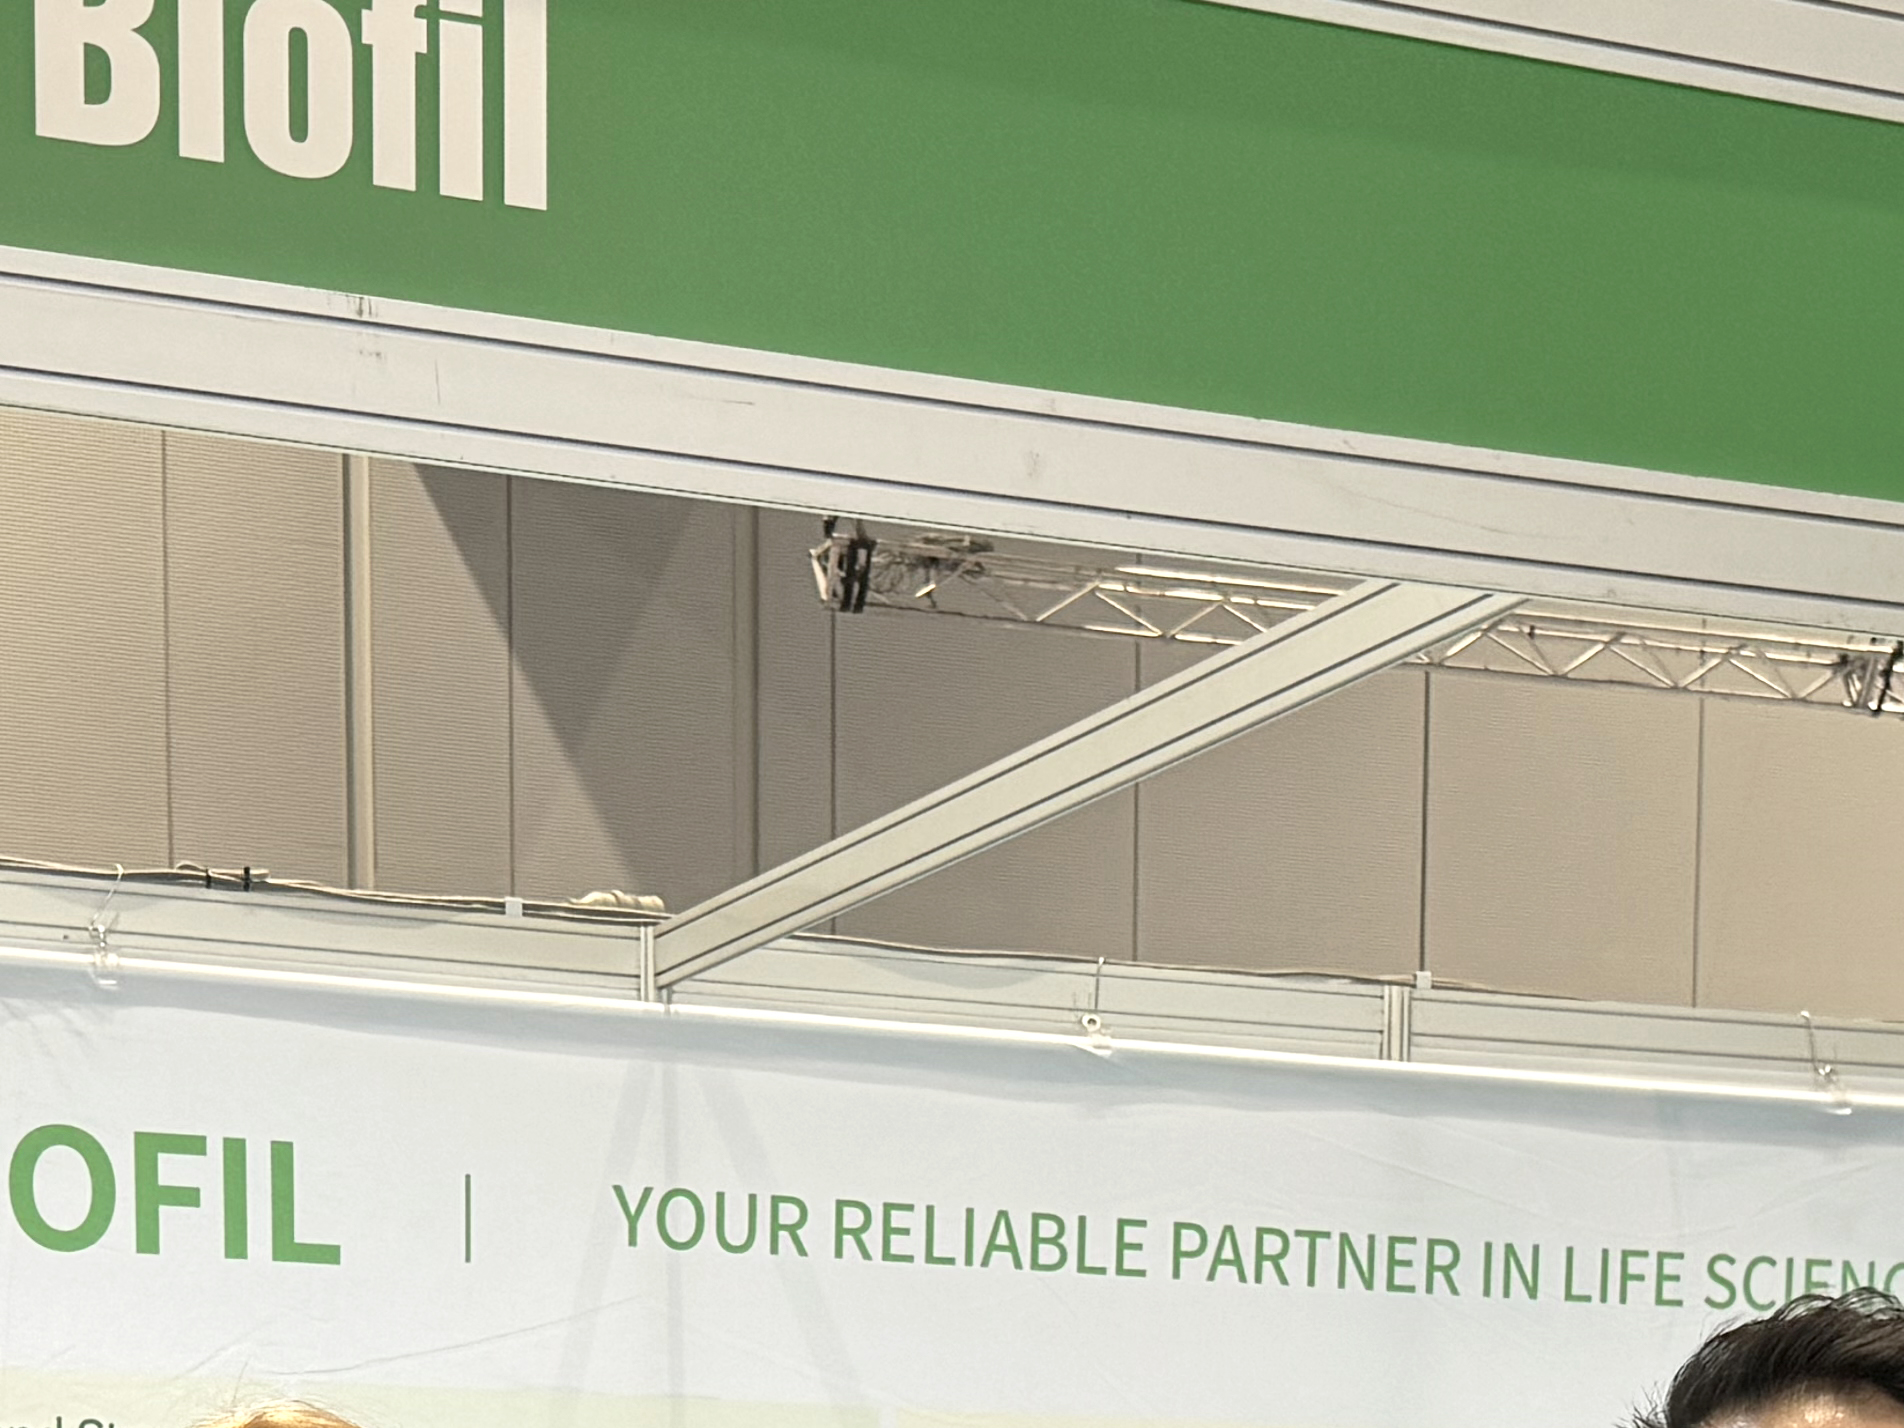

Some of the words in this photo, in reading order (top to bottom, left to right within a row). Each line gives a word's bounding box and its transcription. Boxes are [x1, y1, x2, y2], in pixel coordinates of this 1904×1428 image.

[612, 1184, 808, 1258] YOUR
[834, 1199, 1148, 1278] RELIABLE
[1172, 1221, 1461, 1297] PARTNER
[1482, 1241, 1540, 1301] IN
[1564, 1246, 1686, 1308] LIFE
